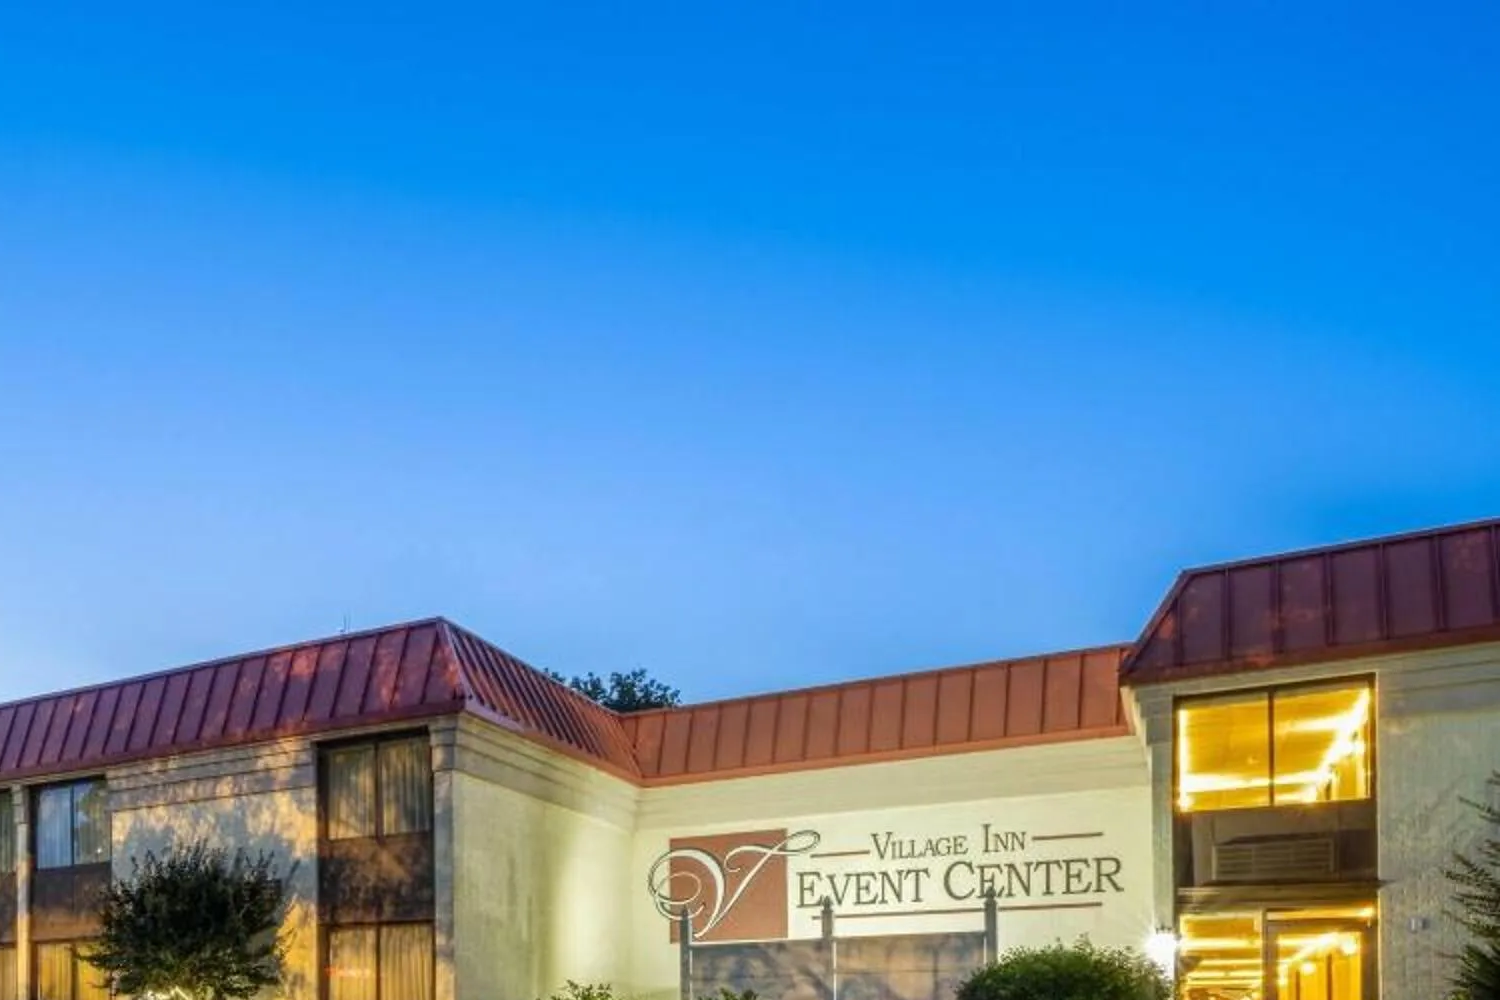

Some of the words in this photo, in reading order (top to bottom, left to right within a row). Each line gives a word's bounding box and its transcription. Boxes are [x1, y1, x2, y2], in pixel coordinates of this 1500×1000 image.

[871, 832, 969, 860] VILLAGE
[982, 823, 1026, 853] INN
[796, 868, 930, 908] EVENT
[943, 857, 1125, 900] CENTER
